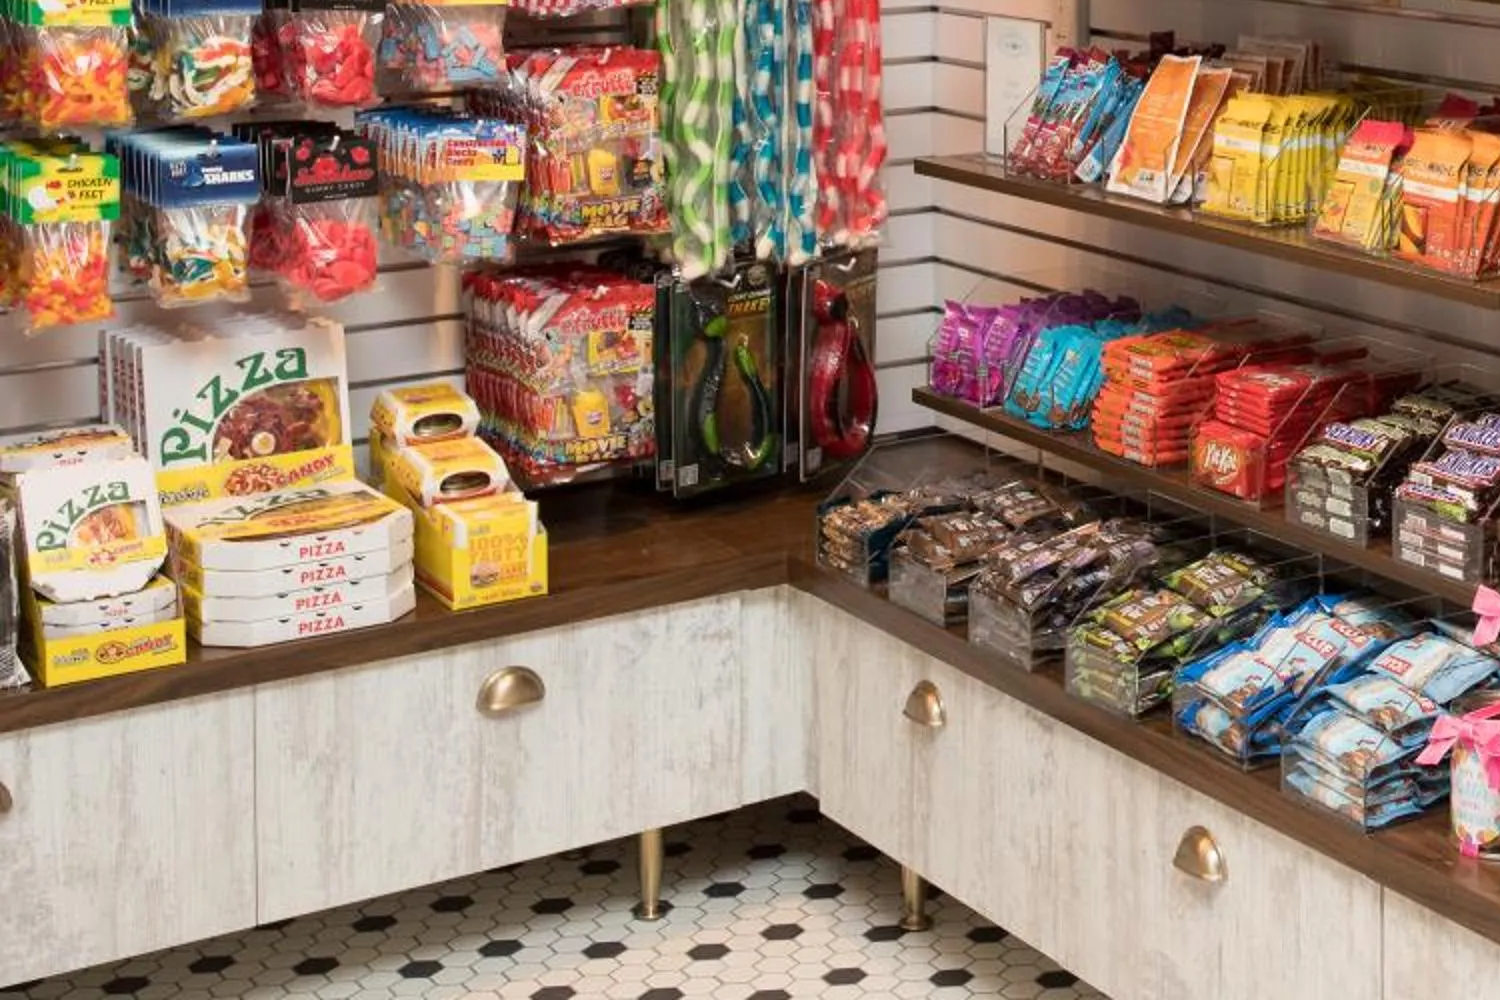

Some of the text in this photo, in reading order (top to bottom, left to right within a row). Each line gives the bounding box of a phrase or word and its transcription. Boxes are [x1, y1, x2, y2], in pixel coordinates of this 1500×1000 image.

[67, 178, 112, 189] CHICKEN
[203, 169, 254, 185] SHARKS
[79, 190, 105, 200] FEET
[160, 345, 310, 467] Pizza
[36, 481, 131, 553] Pizza
[299, 541, 345, 558] PIZZA
[300, 565, 346, 583] PIZZA
[295, 590, 342, 610] PIZZA
[298, 615, 345, 634] PIZZA
